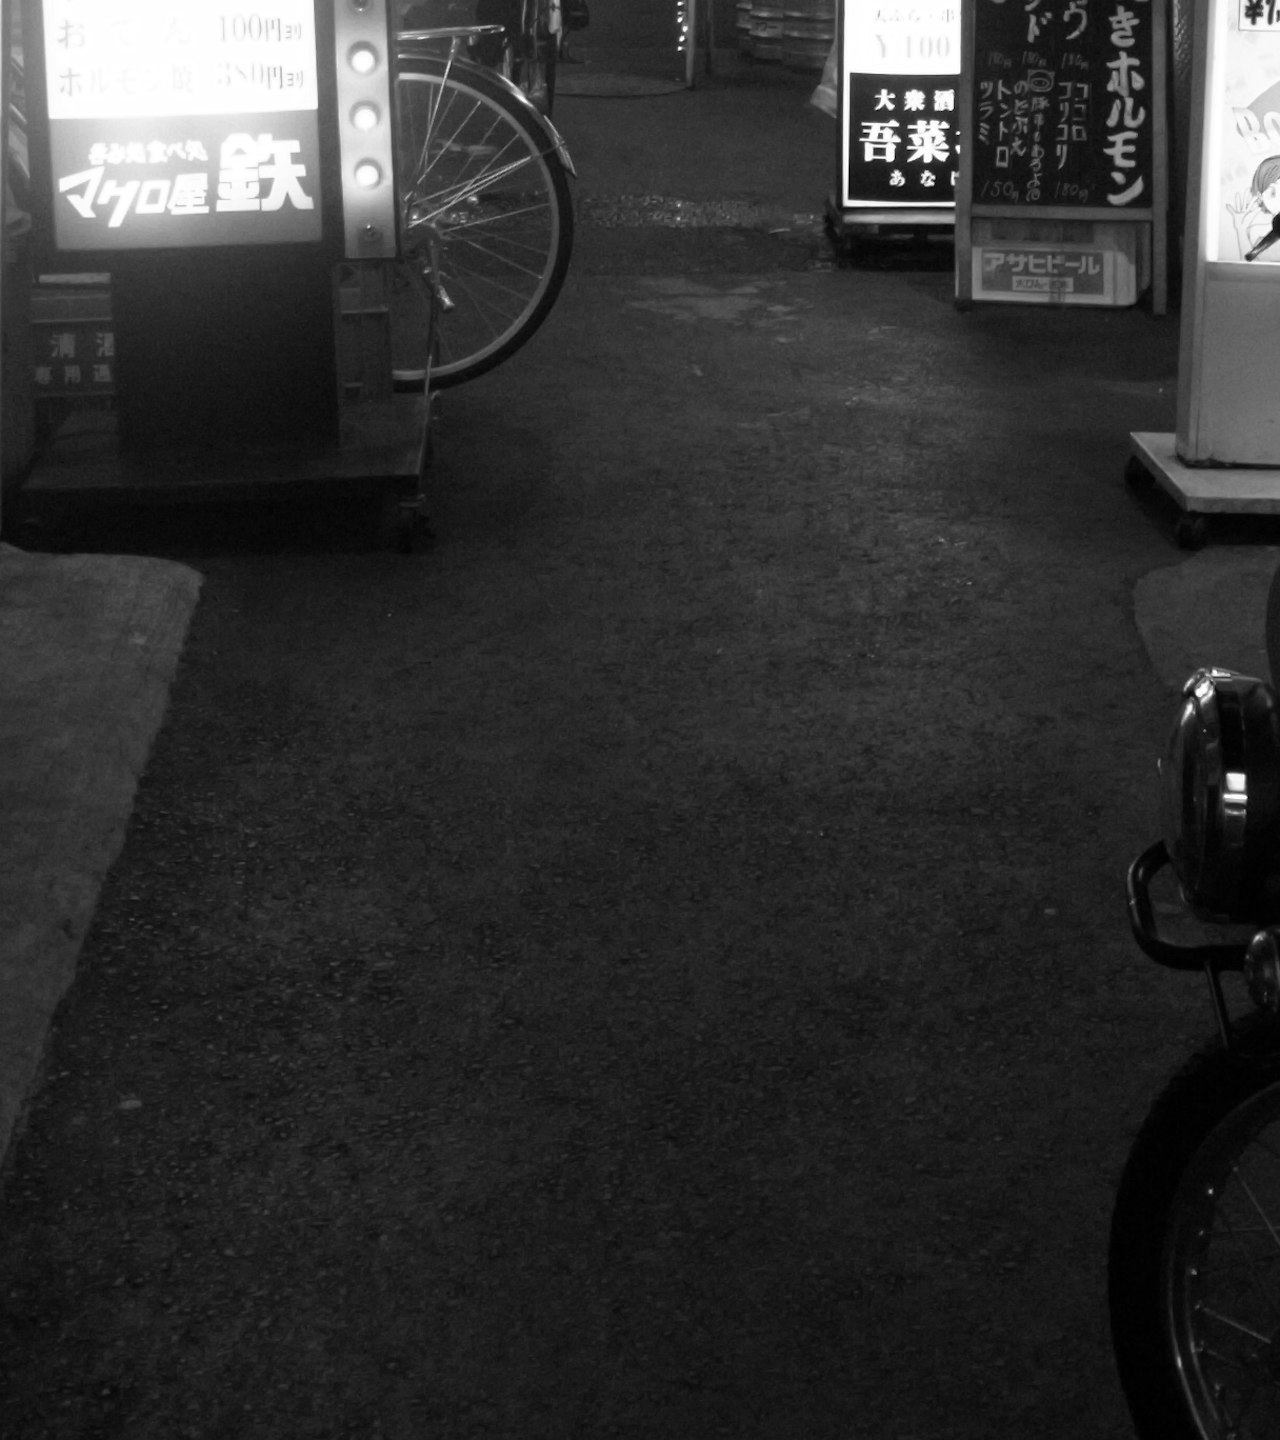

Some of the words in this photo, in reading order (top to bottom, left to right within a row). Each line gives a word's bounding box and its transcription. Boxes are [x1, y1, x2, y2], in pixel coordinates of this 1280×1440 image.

[858, 119, 962, 163] 吾菜
[978, 80, 995, 146] ツラミ
[995, 79, 1012, 169] トントロ
[1055, 82, 1073, 171] コリコリ
[59, 166, 210, 228] マグロ屋
[983, 252, 1101, 276] アサヒビール
